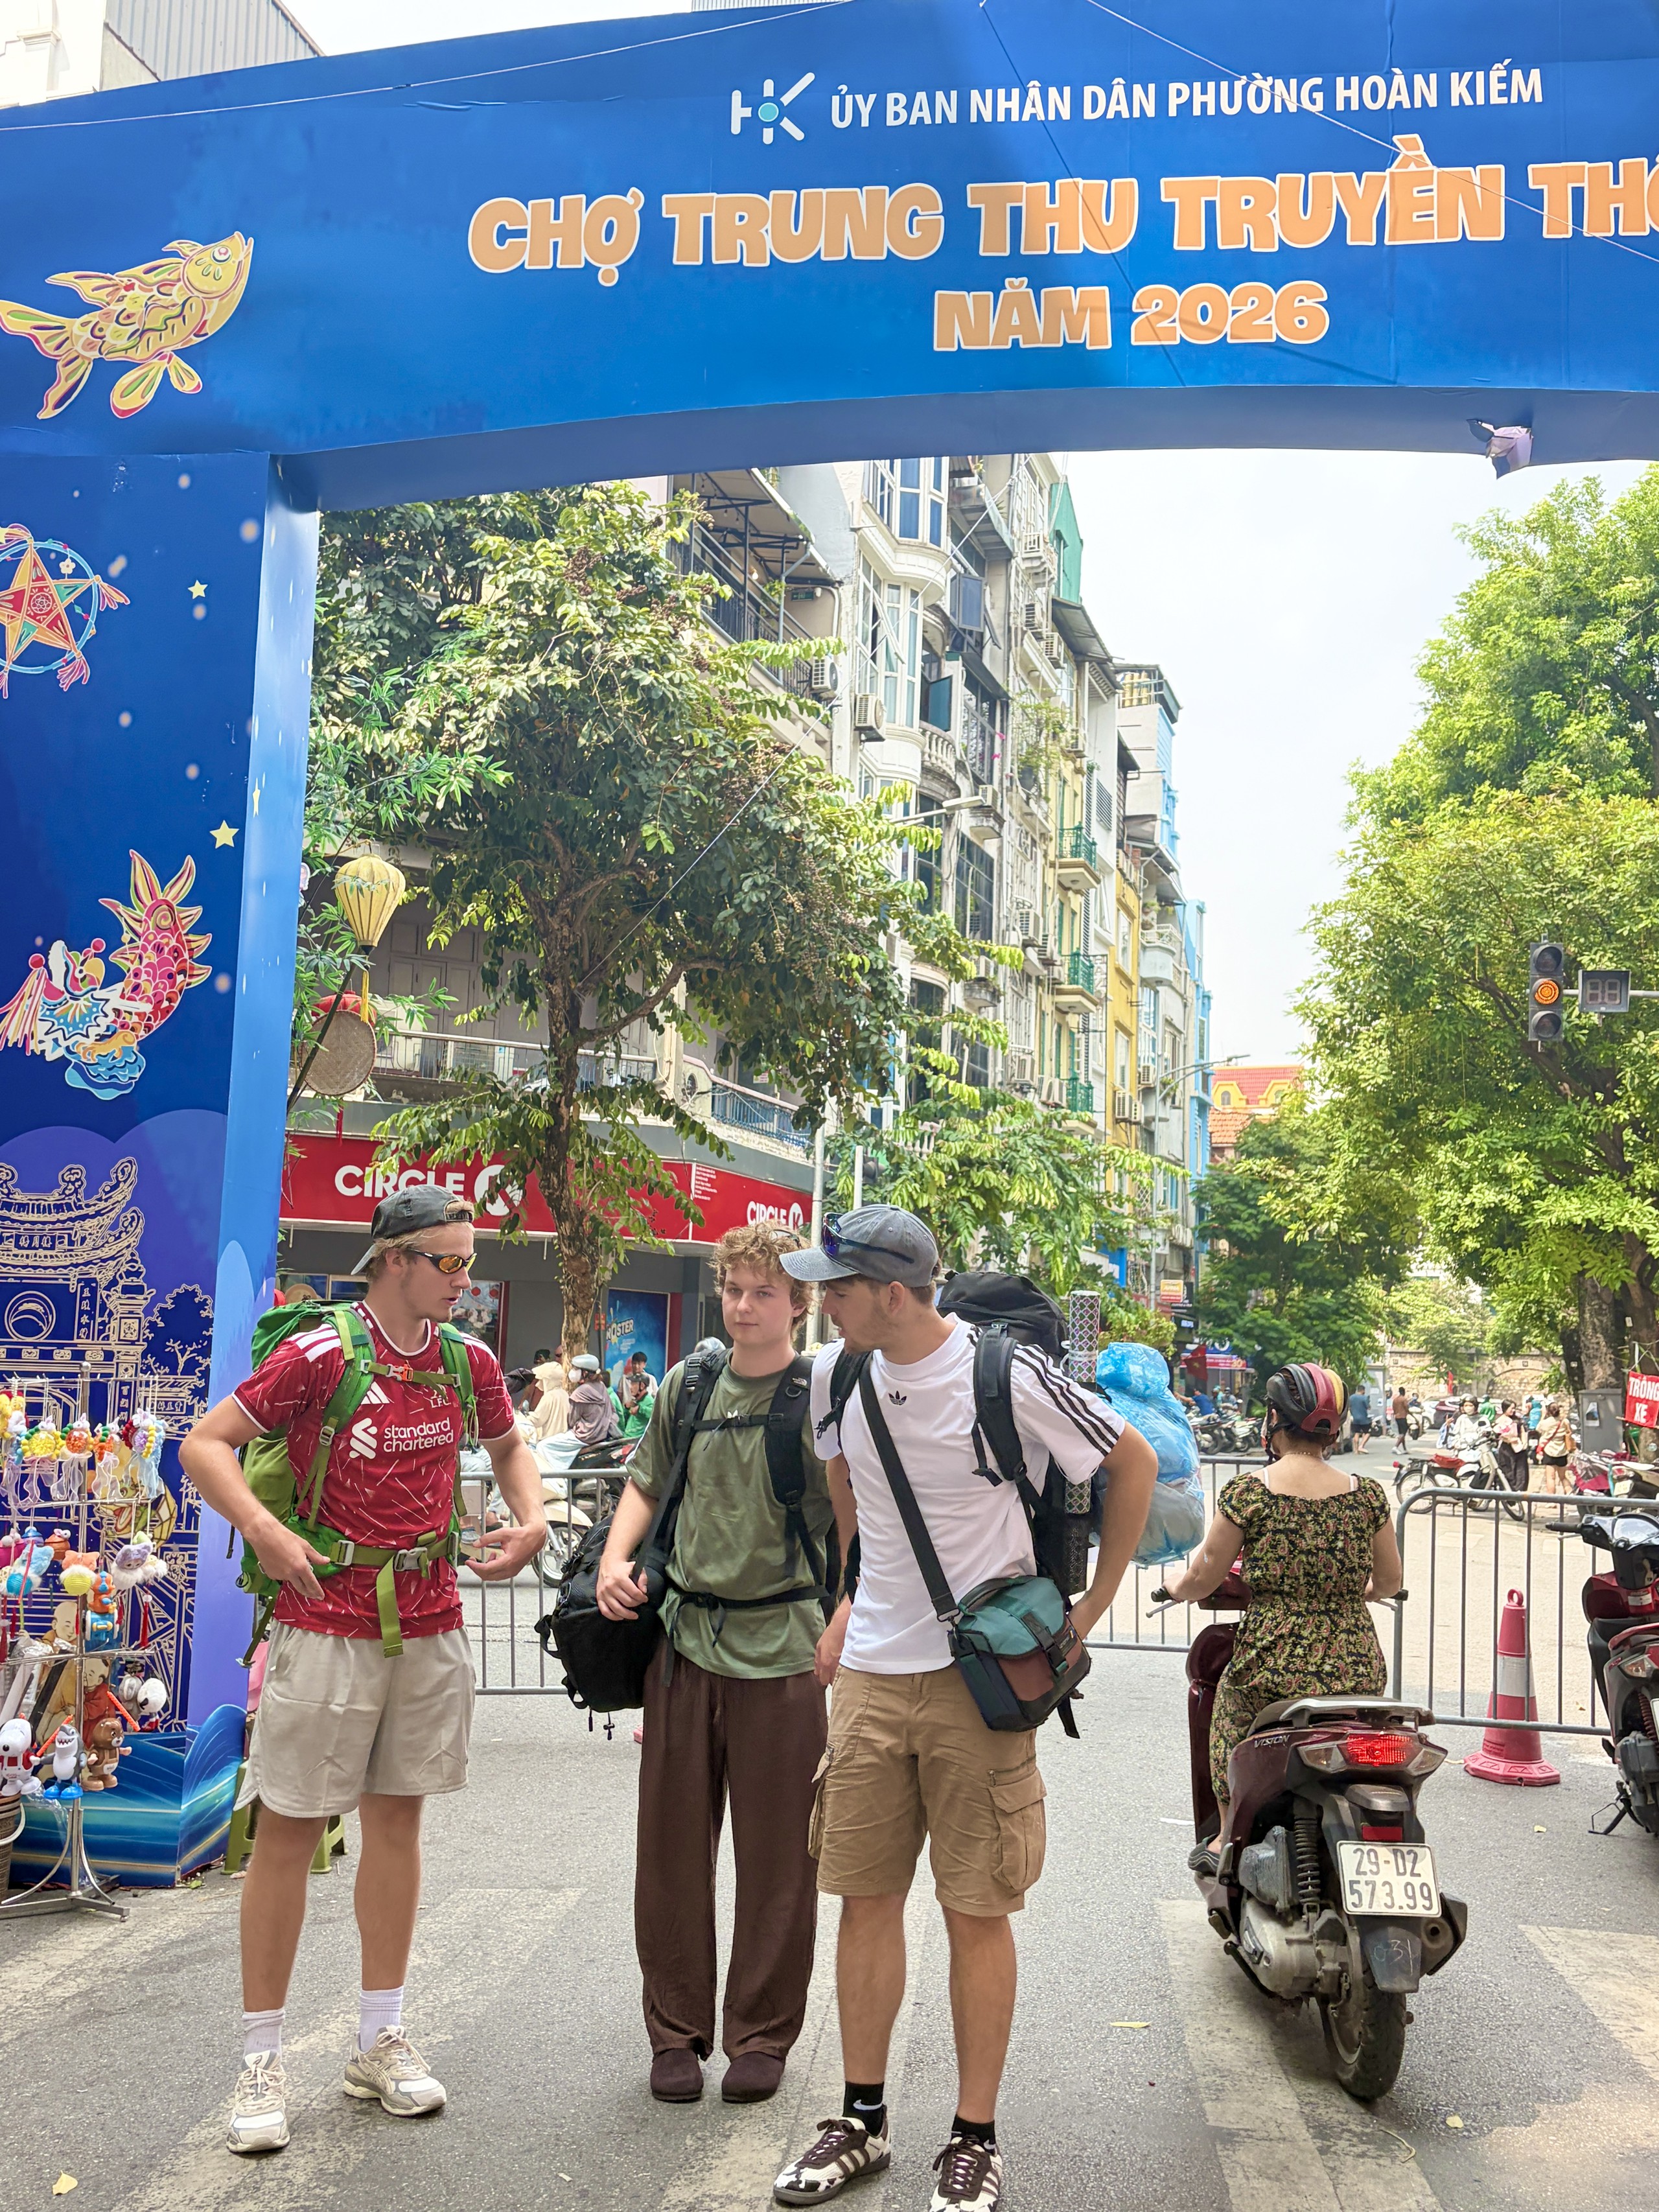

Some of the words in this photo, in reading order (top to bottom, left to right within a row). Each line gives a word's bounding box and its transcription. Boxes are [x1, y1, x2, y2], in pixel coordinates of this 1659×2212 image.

[831, 84, 877, 129] ỦY
[885, 89, 958, 126] BAN
[970, 80, 1071, 123] NHÂN
[1083, 77, 1155, 120] DÂN
[1168, 72, 1324, 117] PHƯỜNG
[1335, 68, 1437, 111] HOÀN
[1450, 58, 1543, 107] KIẾM
[468, 187, 645, 286] CHỢ
[662, 183, 944, 267] TRUNG
[967, 178, 1139, 256] THU
[1160, 134, 1505, 253] TRUYỀN
[1527, 154, 1659, 239] TH
[933, 277, 1112, 351] NĂM
[1131, 281, 1329, 345] 2026
[384, 1417, 450, 1439] standard
[1634, 1403, 1648, 1424] XE
[383, 1429, 454, 1452] chartered
[1254, 1734, 1290, 1748] VISION
[1352, 1848, 1421, 1878] 29-D2
[1349, 1880, 1433, 1911] 573.99
